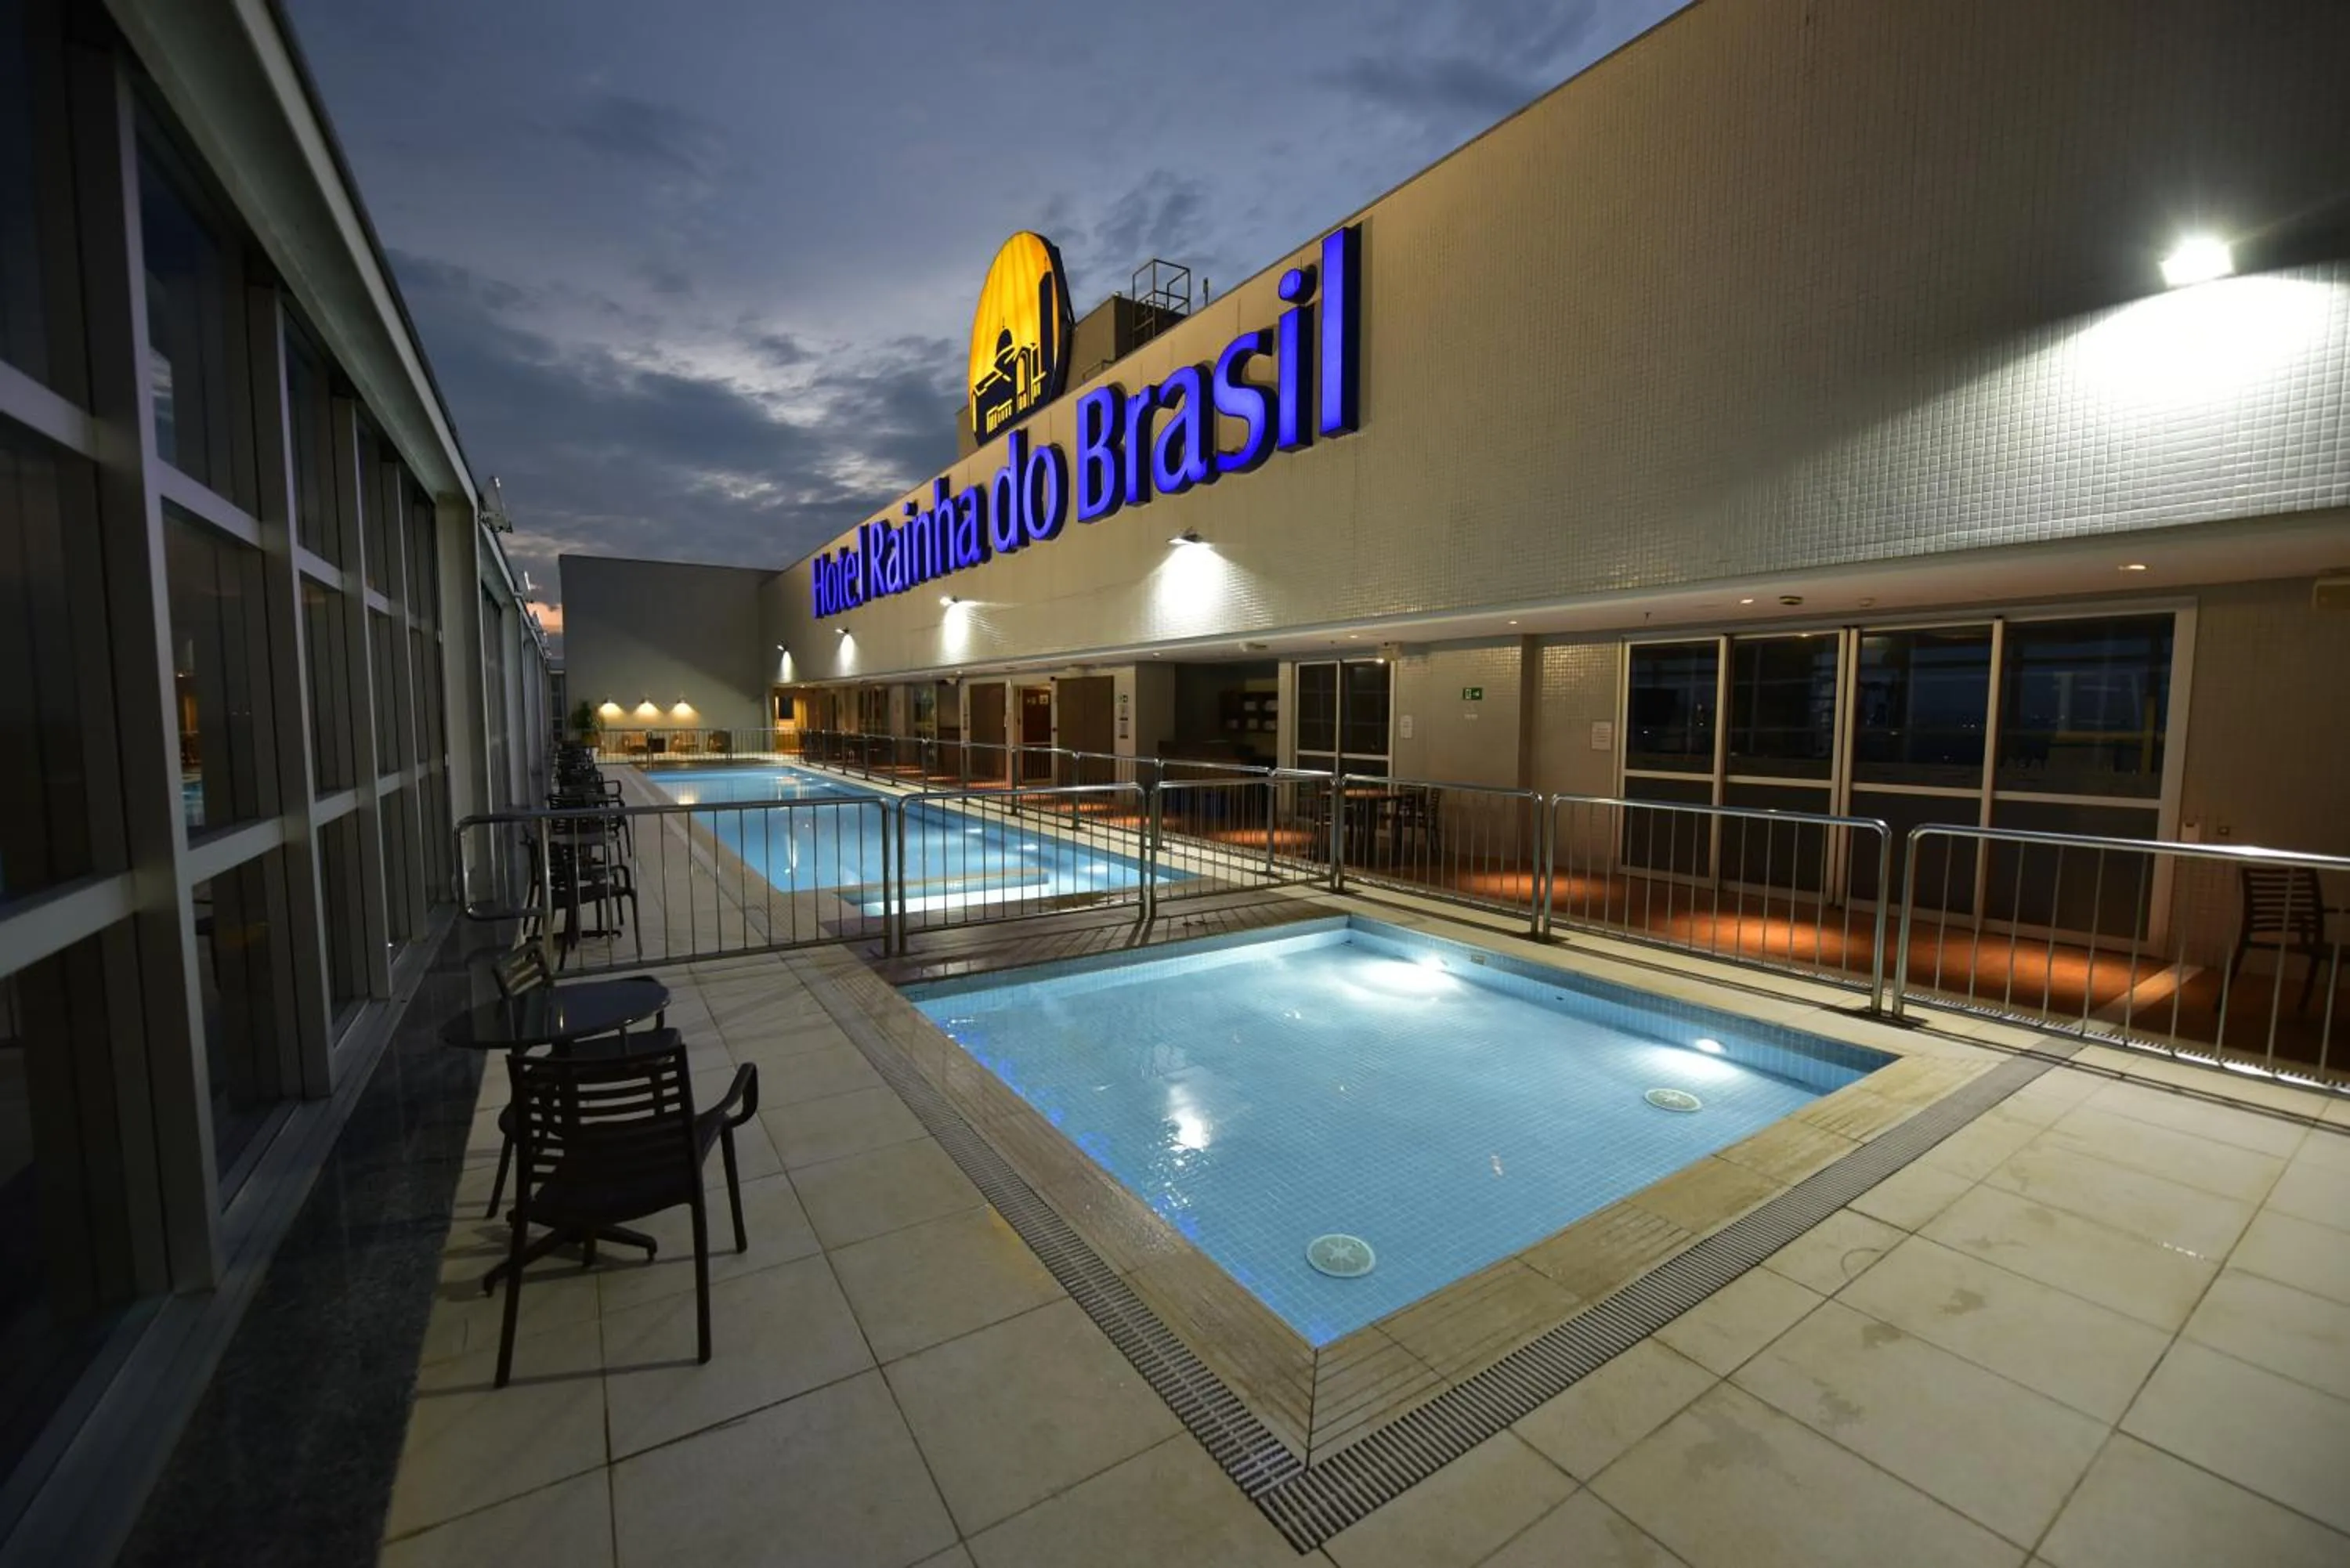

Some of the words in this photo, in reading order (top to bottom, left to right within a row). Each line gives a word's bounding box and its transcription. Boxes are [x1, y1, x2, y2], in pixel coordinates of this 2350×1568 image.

[812, 525, 867, 618] Hotel
[870, 477, 985, 599] Rainha
[991, 429, 1061, 553] do
[1076, 226, 1354, 523] Brasil
